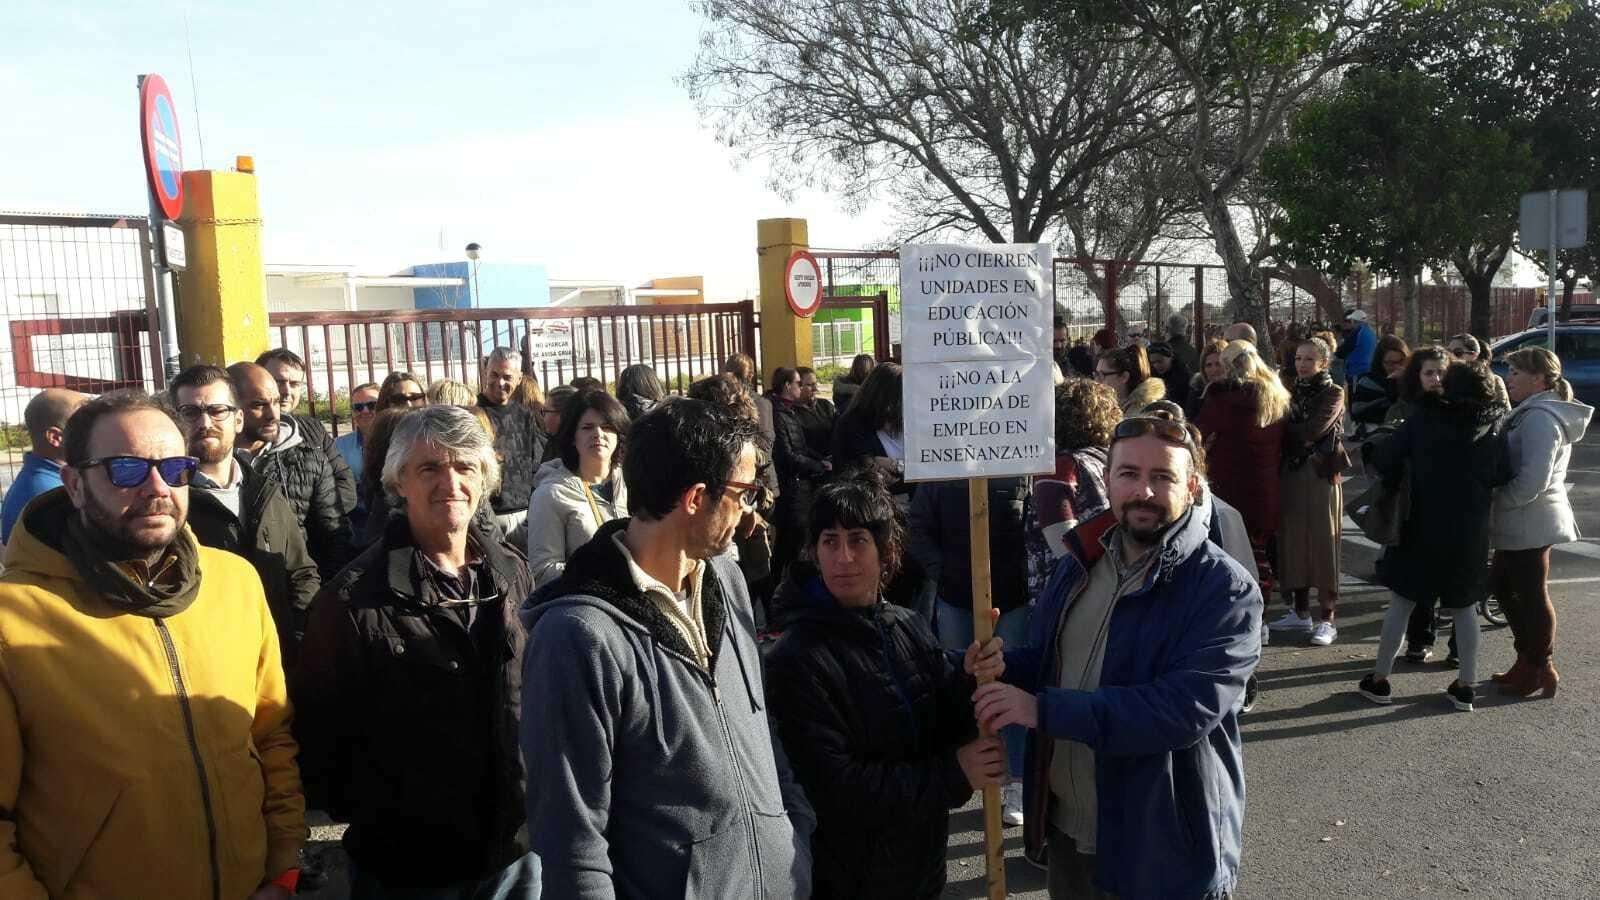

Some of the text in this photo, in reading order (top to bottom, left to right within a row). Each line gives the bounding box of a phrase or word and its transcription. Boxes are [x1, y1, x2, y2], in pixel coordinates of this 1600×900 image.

[919, 253, 1038, 272] ¡¡¡NO CIERREN
[921, 280, 1036, 295] UNIDADES EN
[928, 301, 1028, 321] EDUCACIÓN
[933, 329, 1022, 346] PÚBLICA!!!
[939, 370, 1021, 389] ¡¡¡NO A LA
[930, 394, 1030, 412] PÉRDIDA DE
[933, 420, 1027, 437] EMPLEO EN
[921, 444, 1039, 463] ENSEÑANZA!!!
